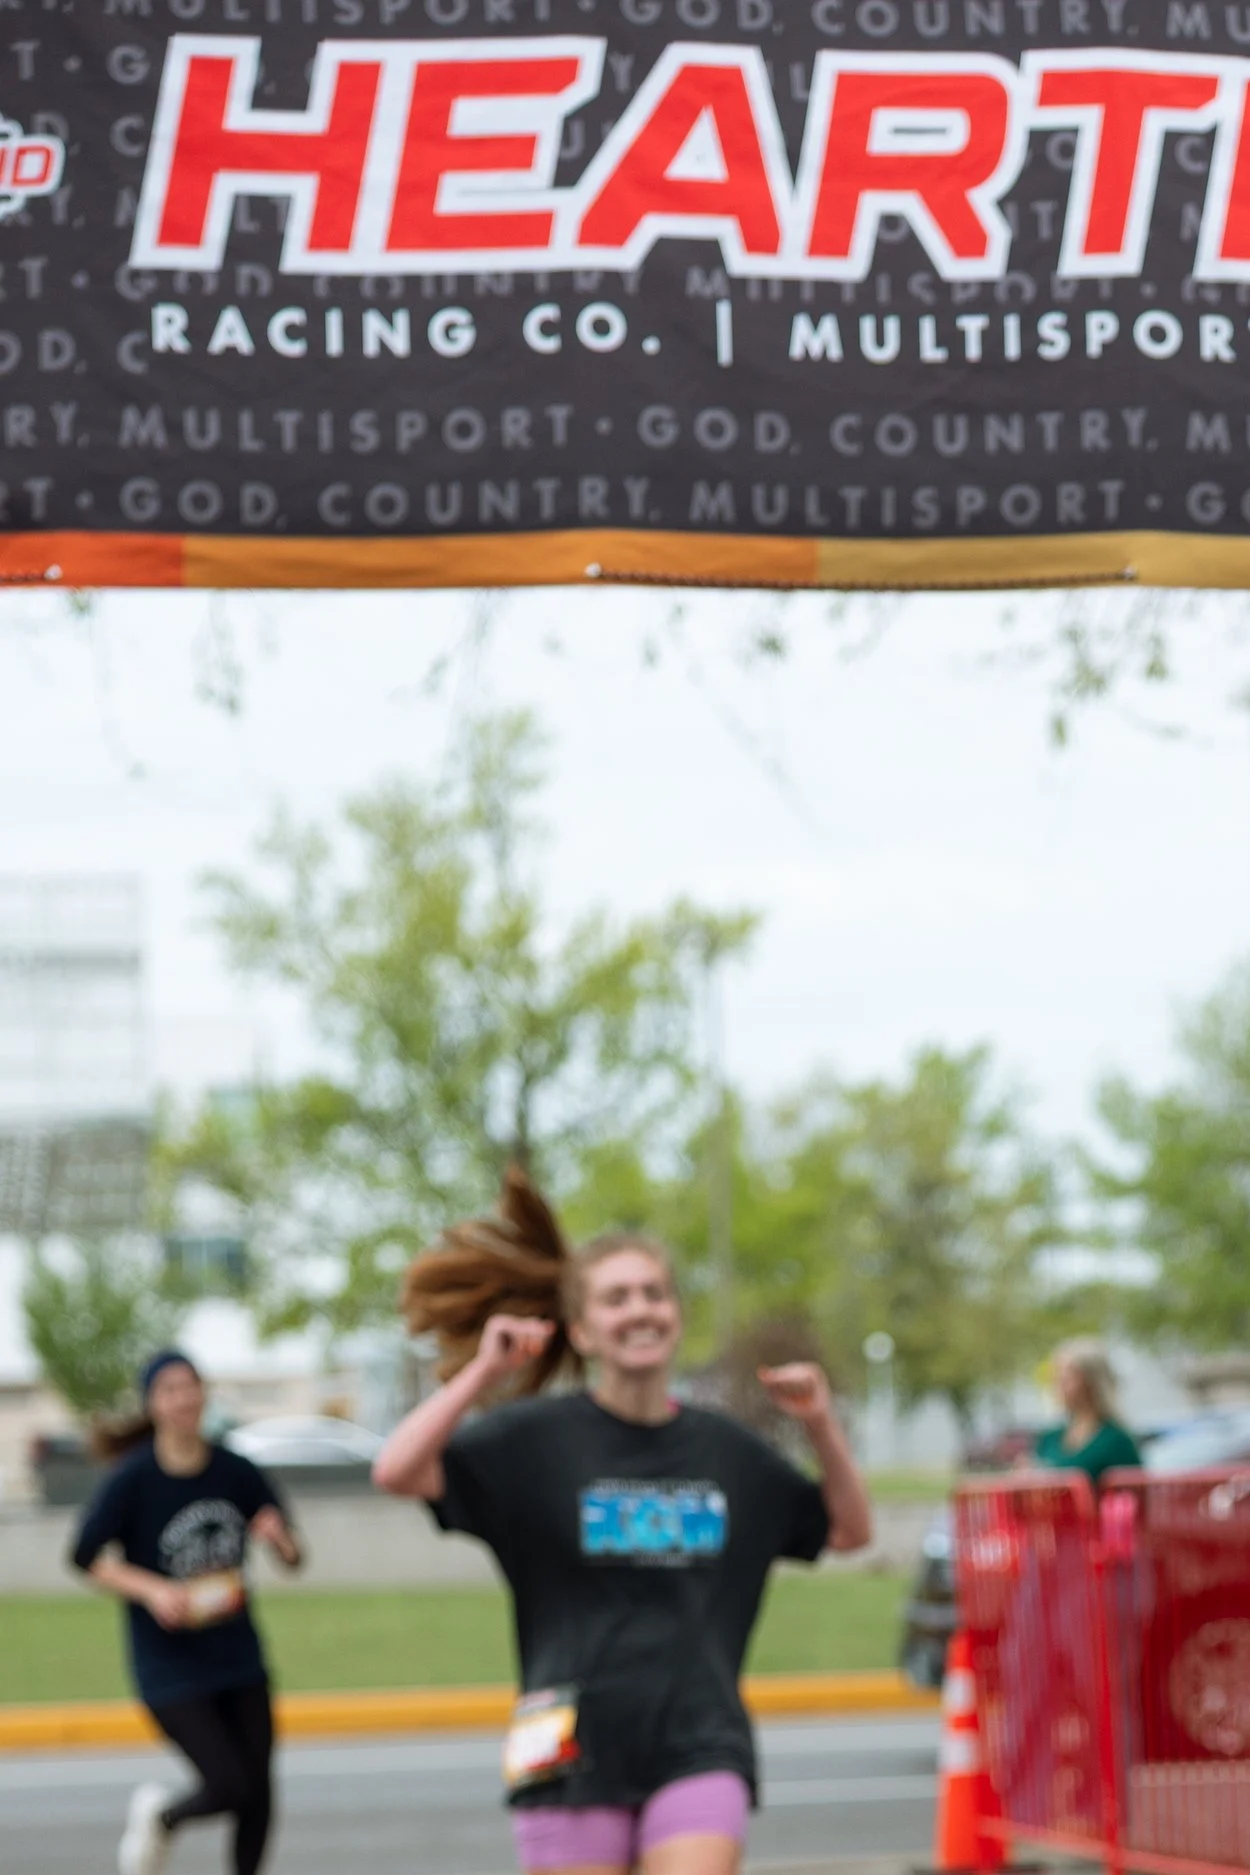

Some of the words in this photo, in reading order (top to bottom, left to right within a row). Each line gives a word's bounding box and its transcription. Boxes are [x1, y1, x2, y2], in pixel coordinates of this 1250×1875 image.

[150, 302, 477, 359] RACING
[521, 302, 662, 354] CO.
[118, 402, 573, 454] MULTISPORT
[636, 404, 798, 456] GOD,
[829, 406, 1158, 457] COUNTRY,
[119, 475, 290, 530] GOD,
[317, 476, 662, 526] COUNTRY,
[688, 479, 1126, 529] MULTISPORT
